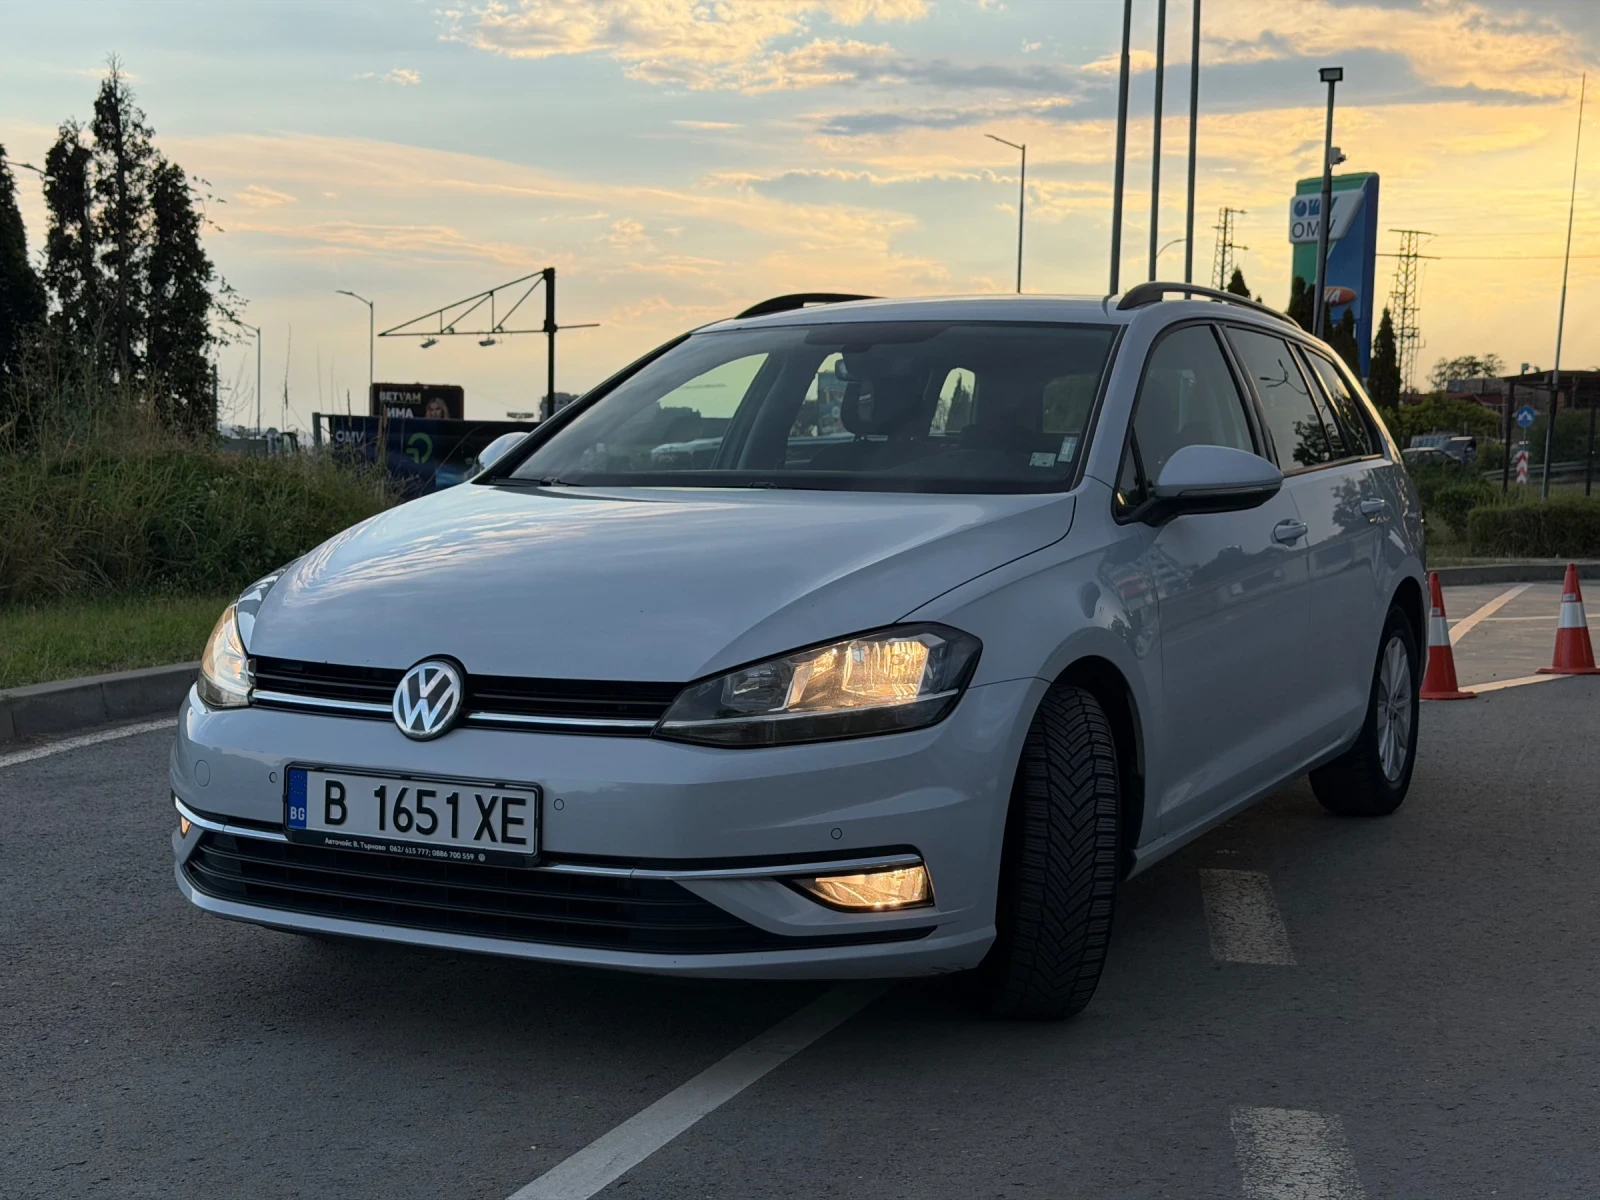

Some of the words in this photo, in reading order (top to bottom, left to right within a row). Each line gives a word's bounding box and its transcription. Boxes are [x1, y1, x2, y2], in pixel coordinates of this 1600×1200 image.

[335, 430, 365, 443] OMV
[393, 661, 461, 735] VW
[290, 806, 305, 821] BG
[324, 779, 347, 826] B
[374, 785, 459, 839] 1651
[473, 793, 527, 845] XE
[360, 841, 386, 851] Търново
[389, 845, 404, 853] 062/
[431, 849, 448, 858] 0886
[448, 851, 461, 859] 700
[462, 852, 475, 860] 559
